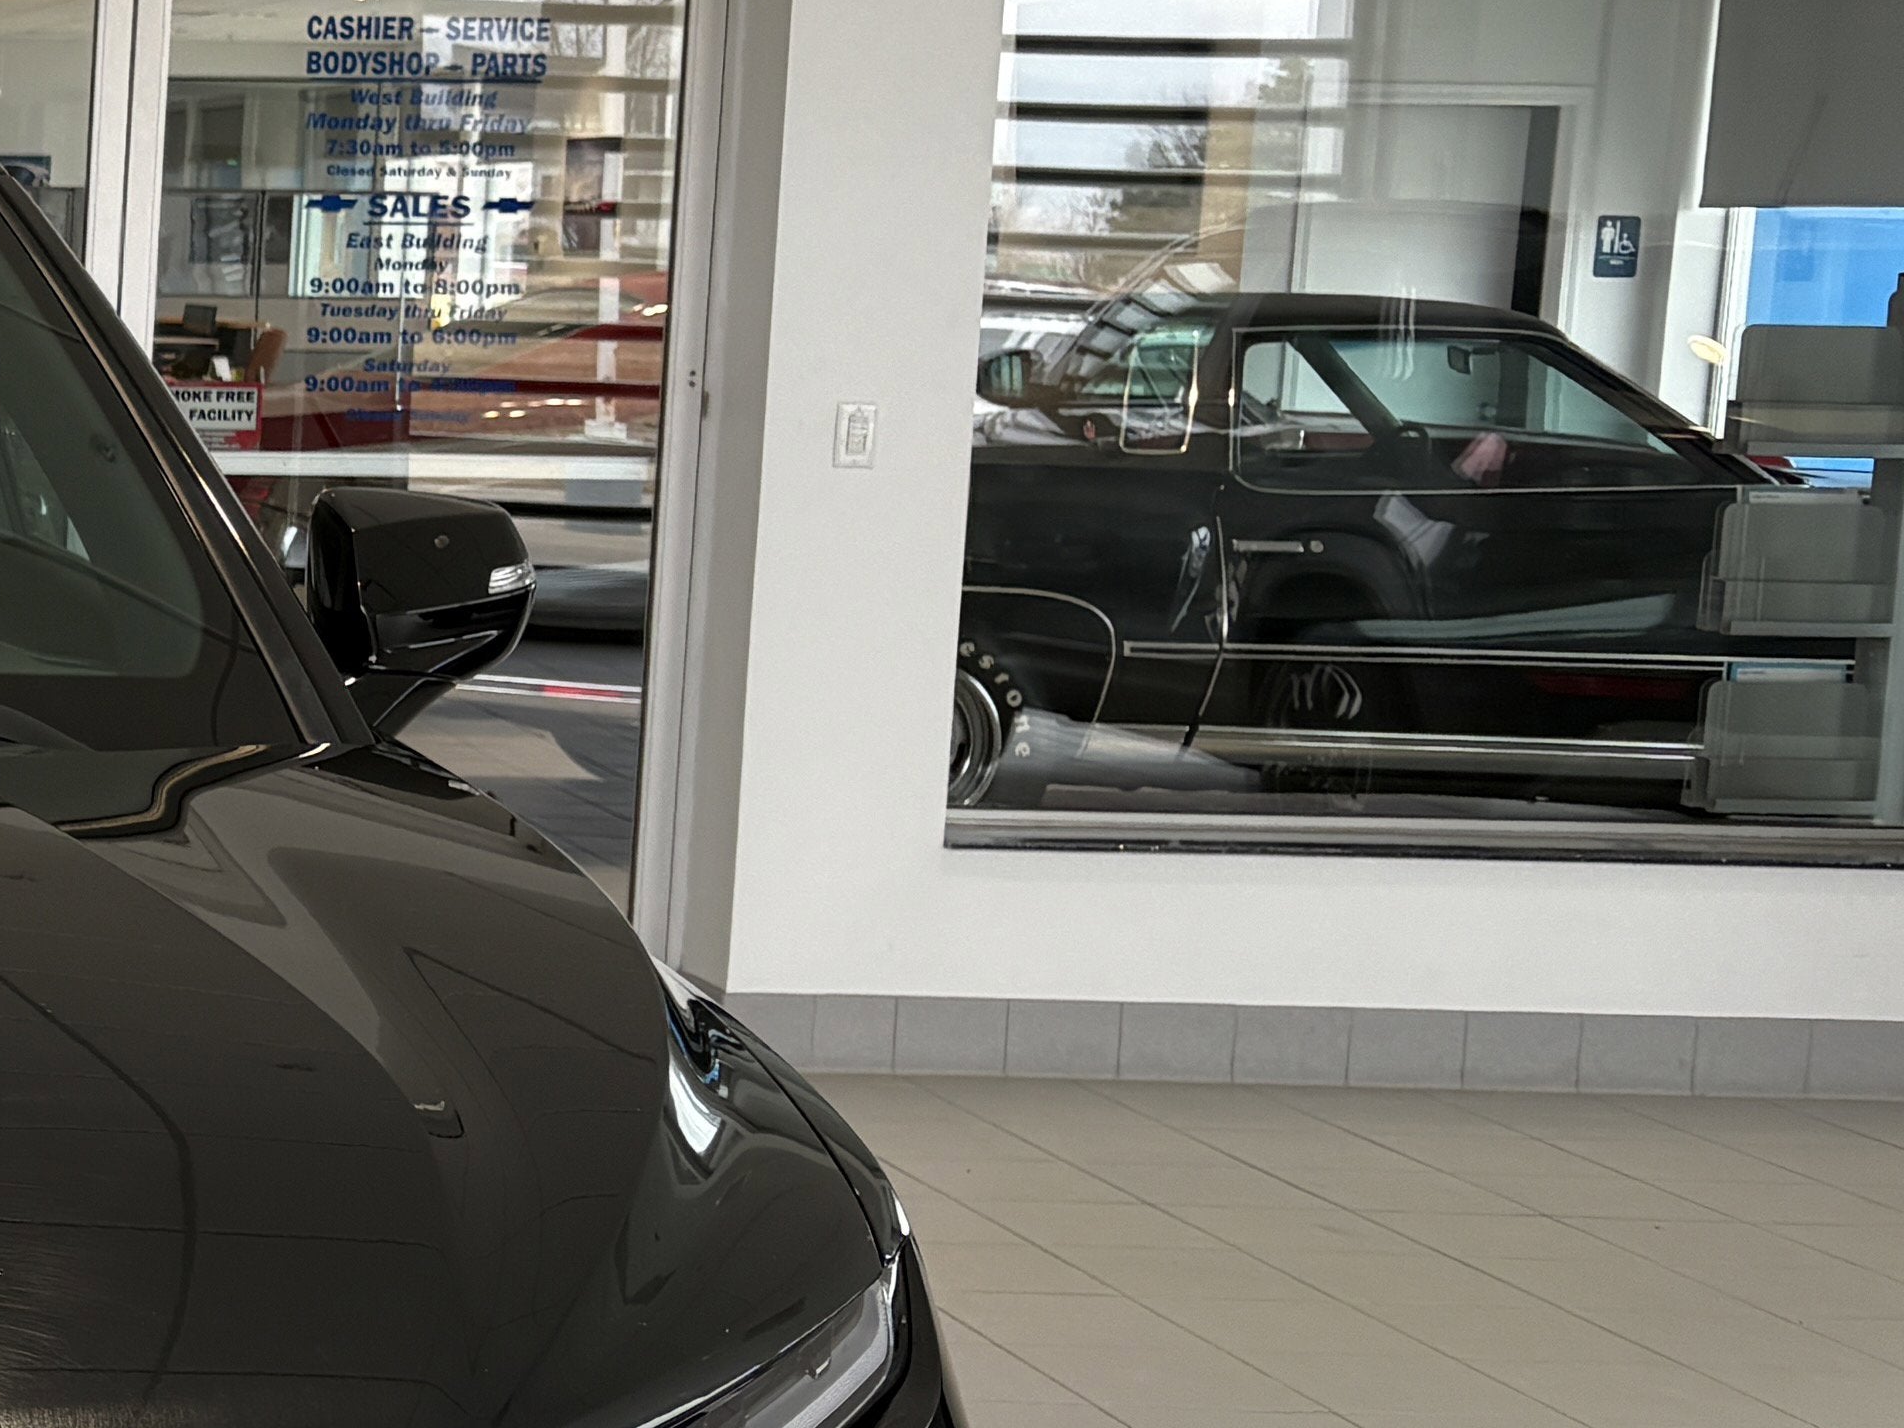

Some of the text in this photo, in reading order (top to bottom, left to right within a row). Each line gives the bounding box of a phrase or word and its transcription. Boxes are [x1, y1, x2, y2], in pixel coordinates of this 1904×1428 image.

[306, 15, 551, 42] CASHIER SERVICE
[306, 51, 547, 76] BODYSHOP PARTS
[350, 88, 498, 109] West Building
[305, 113, 528, 135] Monday thru Friday
[326, 139, 403, 156] 7:30am
[410, 141, 431, 156] to
[326, 164, 375, 176] Closed
[380, 164, 441, 180] Saturday
[461, 165, 512, 181] Sunday
[367, 195, 471, 218] SALES
[346, 233, 489, 254] East Building
[374, 257, 448, 274] Monday
[309, 278, 520, 296] 9:00am to 8:00pm
[320, 303, 508, 322] Tuesday thru Friday
[306, 327, 517, 348] 9:00am to 6:00pm
[363, 358, 452, 376] Saturday
[304, 376, 390, 392] 9:00am
[174, 391, 255, 403] MOKE FREE
[189, 409, 255, 421] FACILITY
[959, 641, 1031, 757] estone
